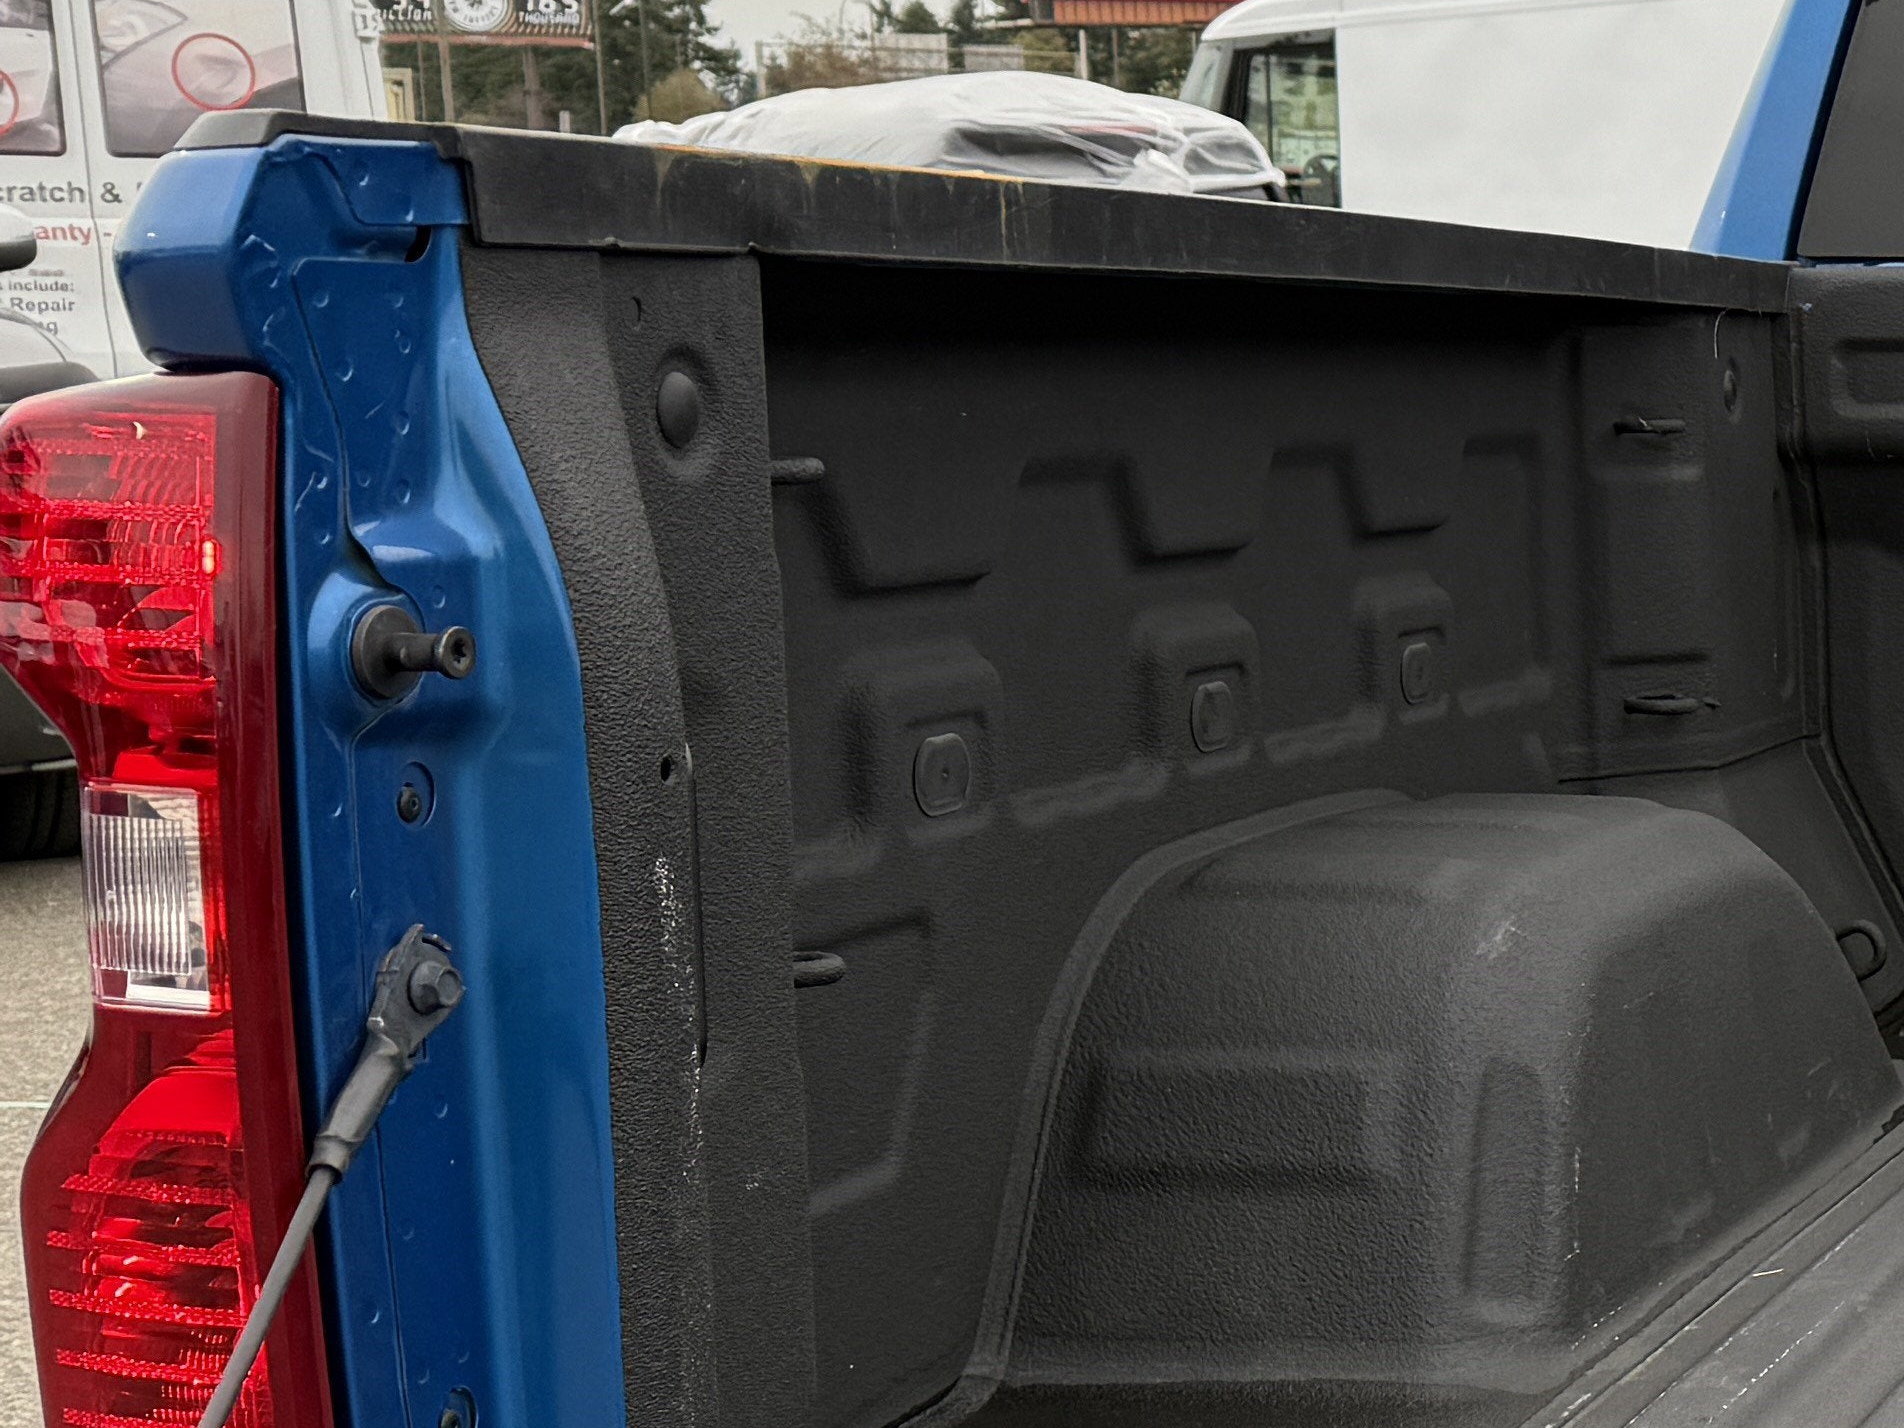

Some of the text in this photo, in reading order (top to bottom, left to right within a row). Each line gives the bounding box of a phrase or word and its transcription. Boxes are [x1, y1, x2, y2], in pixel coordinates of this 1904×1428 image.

[0, 181, 122, 204] ratch &
[10, 297, 75, 314] Repair
